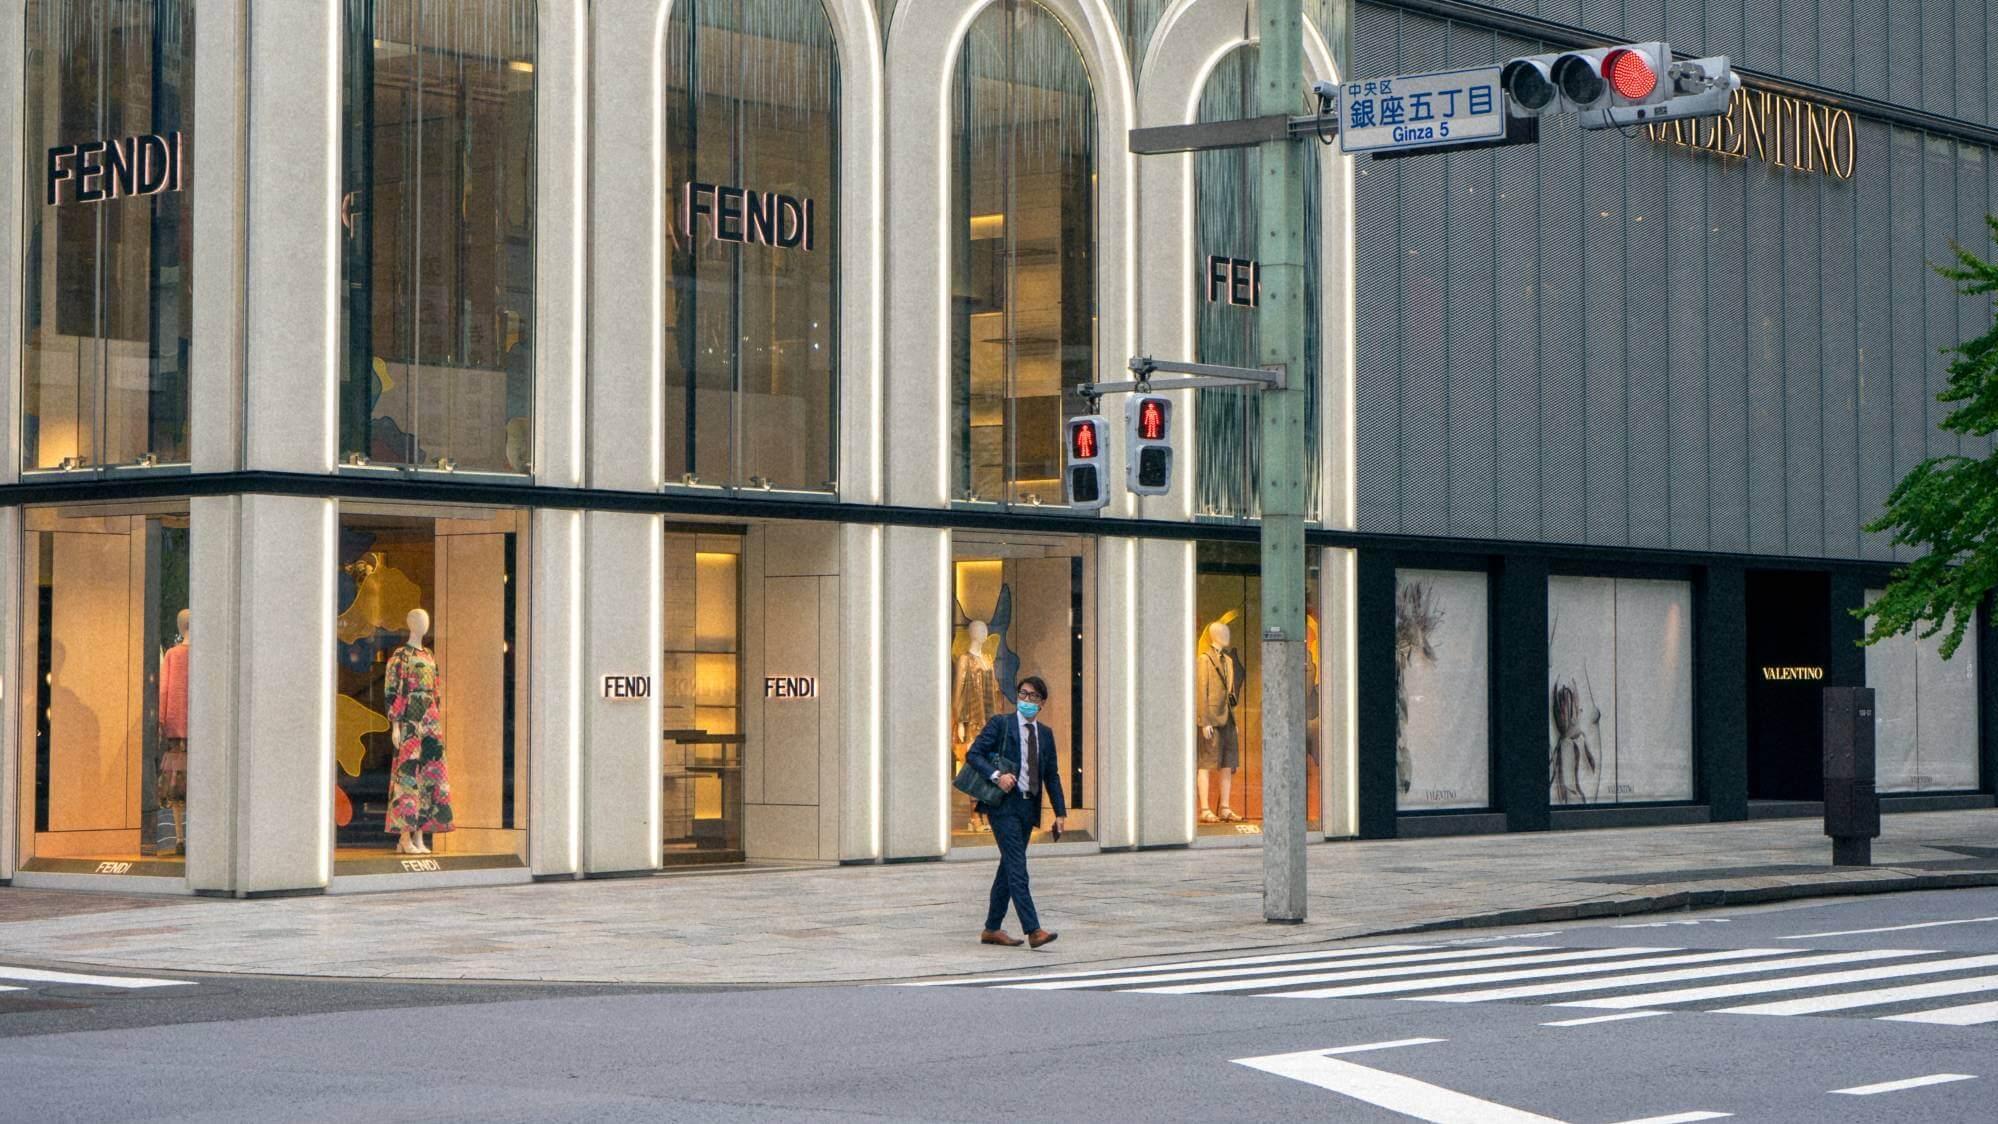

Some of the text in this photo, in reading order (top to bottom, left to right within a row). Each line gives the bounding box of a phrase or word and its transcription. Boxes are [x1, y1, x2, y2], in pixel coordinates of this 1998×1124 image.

[1348, 79, 1393, 98] 中央区
[1350, 85, 1493, 129] 銀座五丁目
[1392, 121, 1450, 143] Ginza 5
[47, 131, 183, 206] FENDI
[683, 181, 814, 251] FENDI
[1762, 666, 1823, 680] VALENTINO
[604, 675, 651, 698] FENDI
[764, 676, 815, 698] FENDI
[95, 861, 133, 874] FENDI
[400, 859, 441, 872] FENDI
